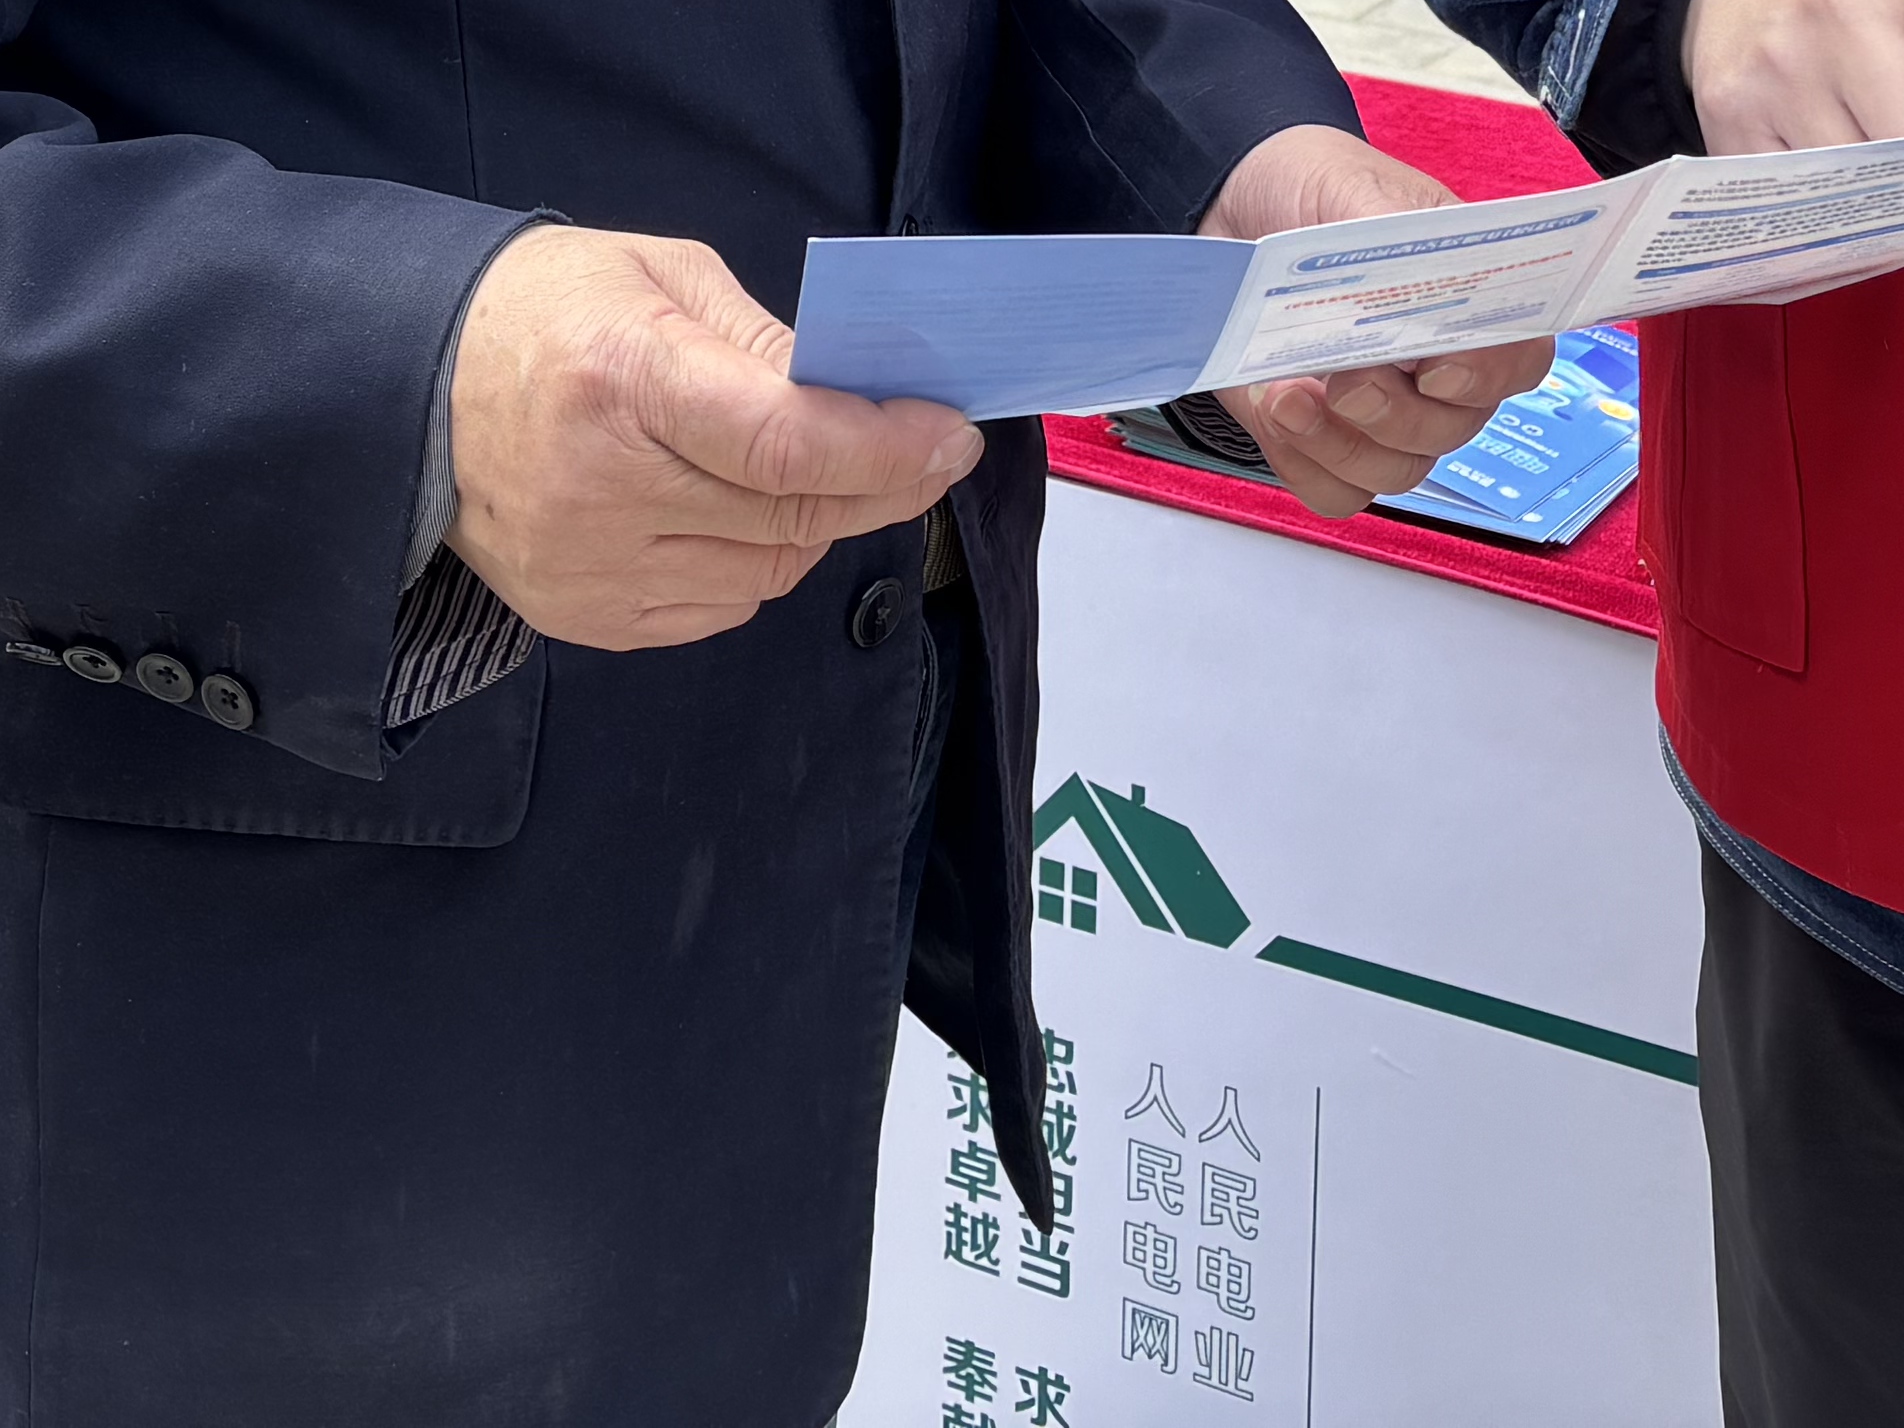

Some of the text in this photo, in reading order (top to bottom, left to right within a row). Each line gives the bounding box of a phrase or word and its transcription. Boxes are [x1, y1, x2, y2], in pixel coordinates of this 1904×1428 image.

[943, 1042, 1001, 1278] 求卓越
[1120, 1062, 1186, 1376] 人民电网
[1192, 1086, 1261, 1403] 人民电业
